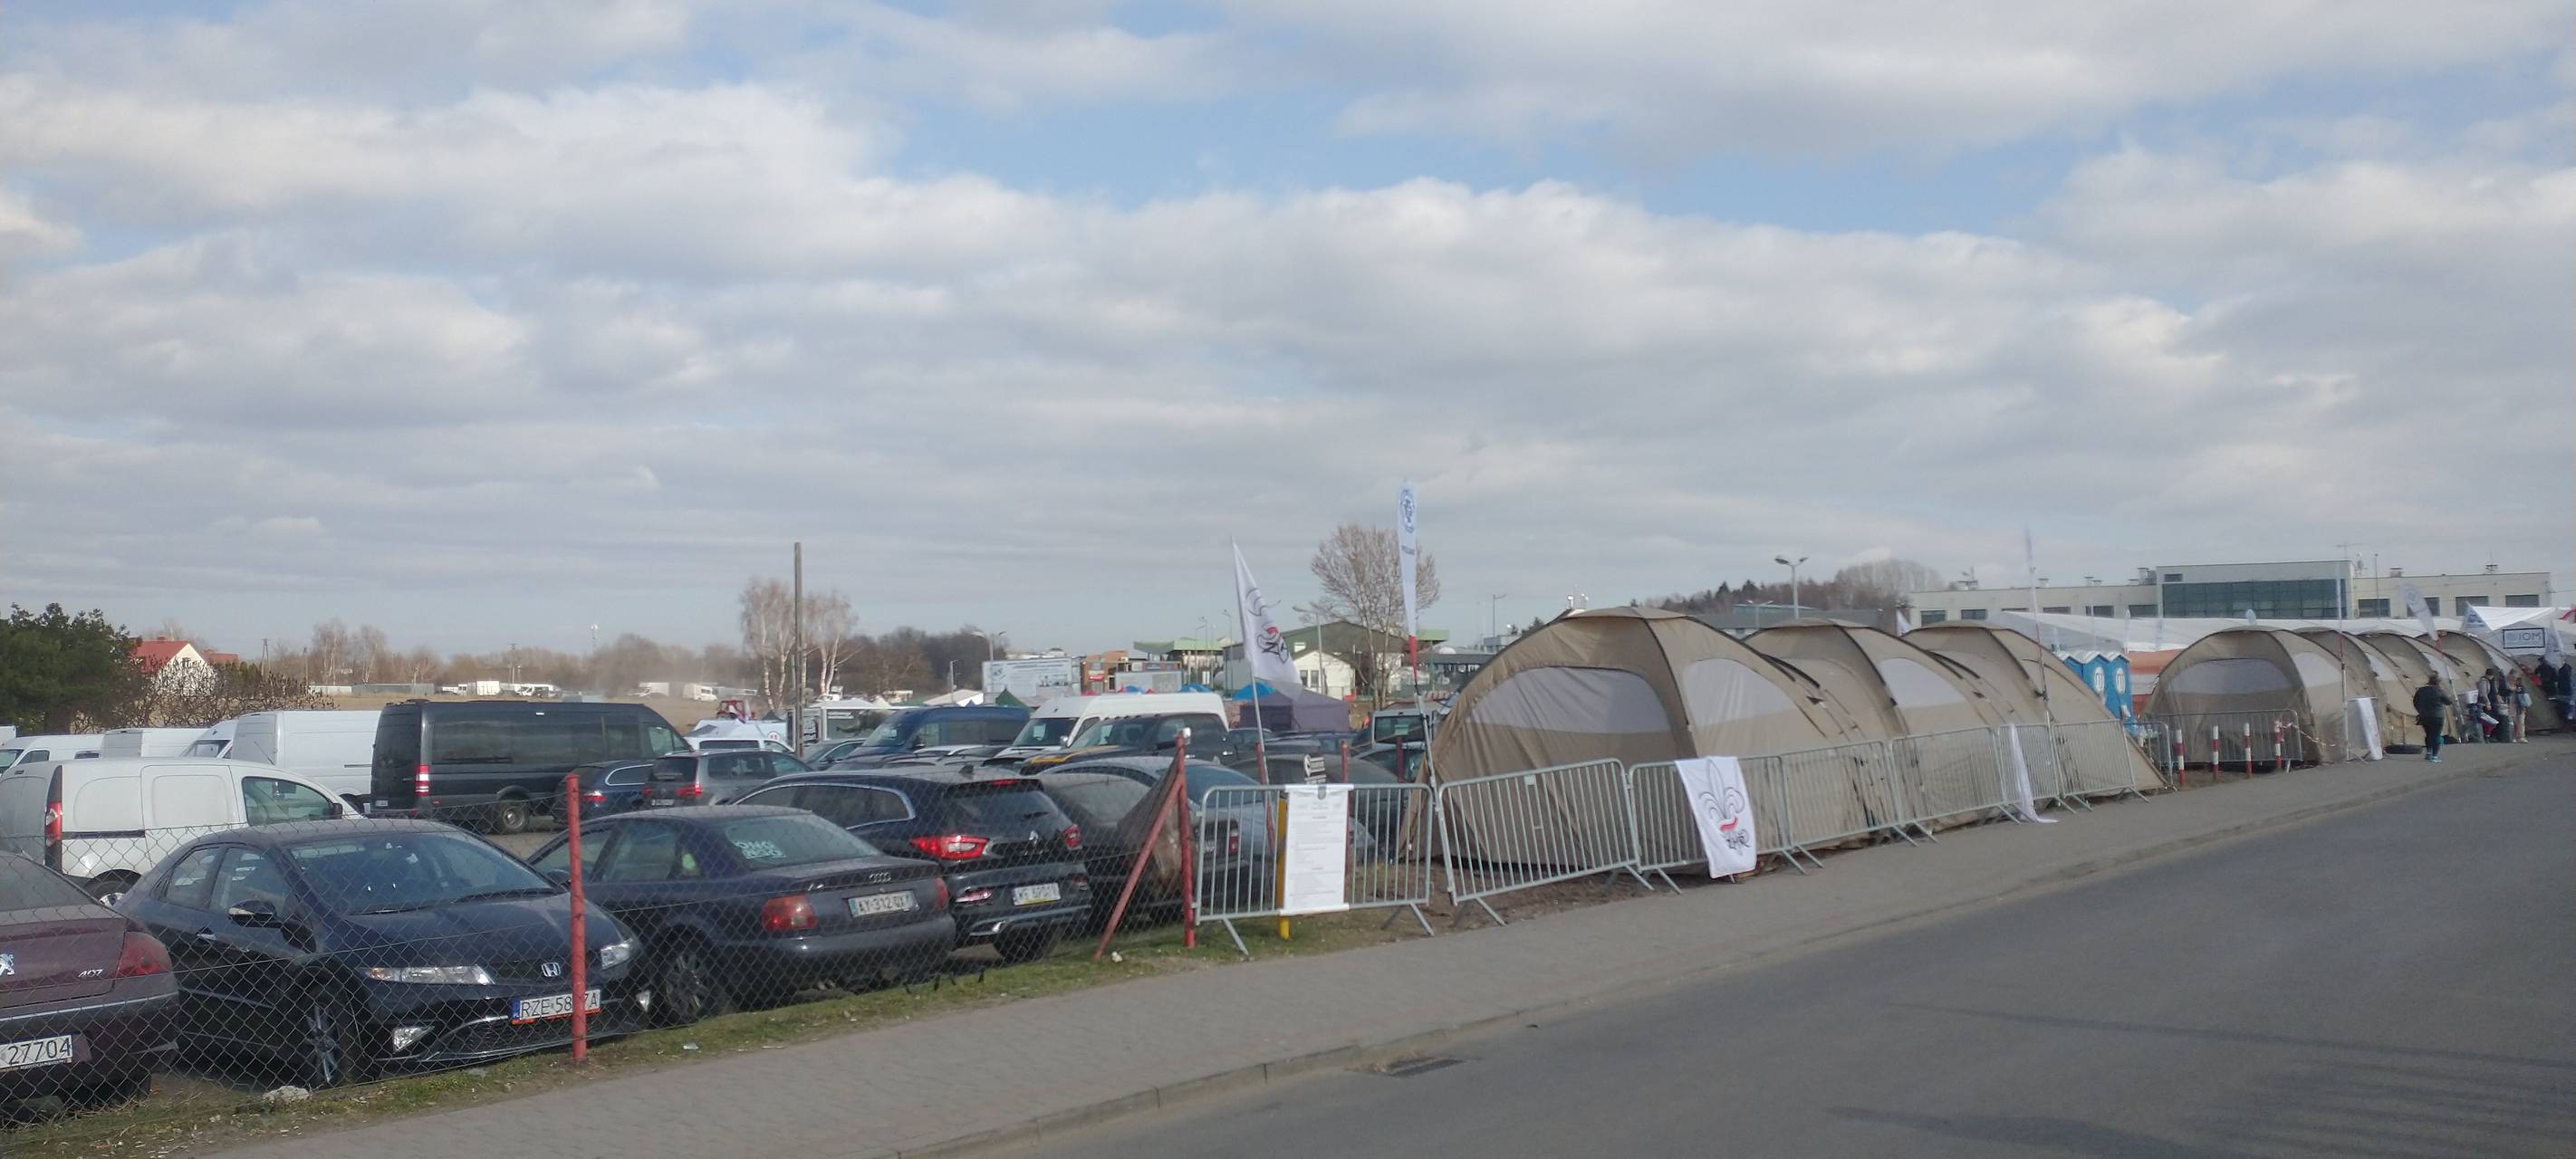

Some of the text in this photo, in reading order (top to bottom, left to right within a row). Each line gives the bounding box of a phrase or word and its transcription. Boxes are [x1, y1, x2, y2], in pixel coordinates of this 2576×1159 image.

[2519, 632, 2542, 641] IOM
[78, 969, 103, 978] 407
[521, 1000, 550, 1018] RZE
[7, 1038, 72, 1065] 27704
